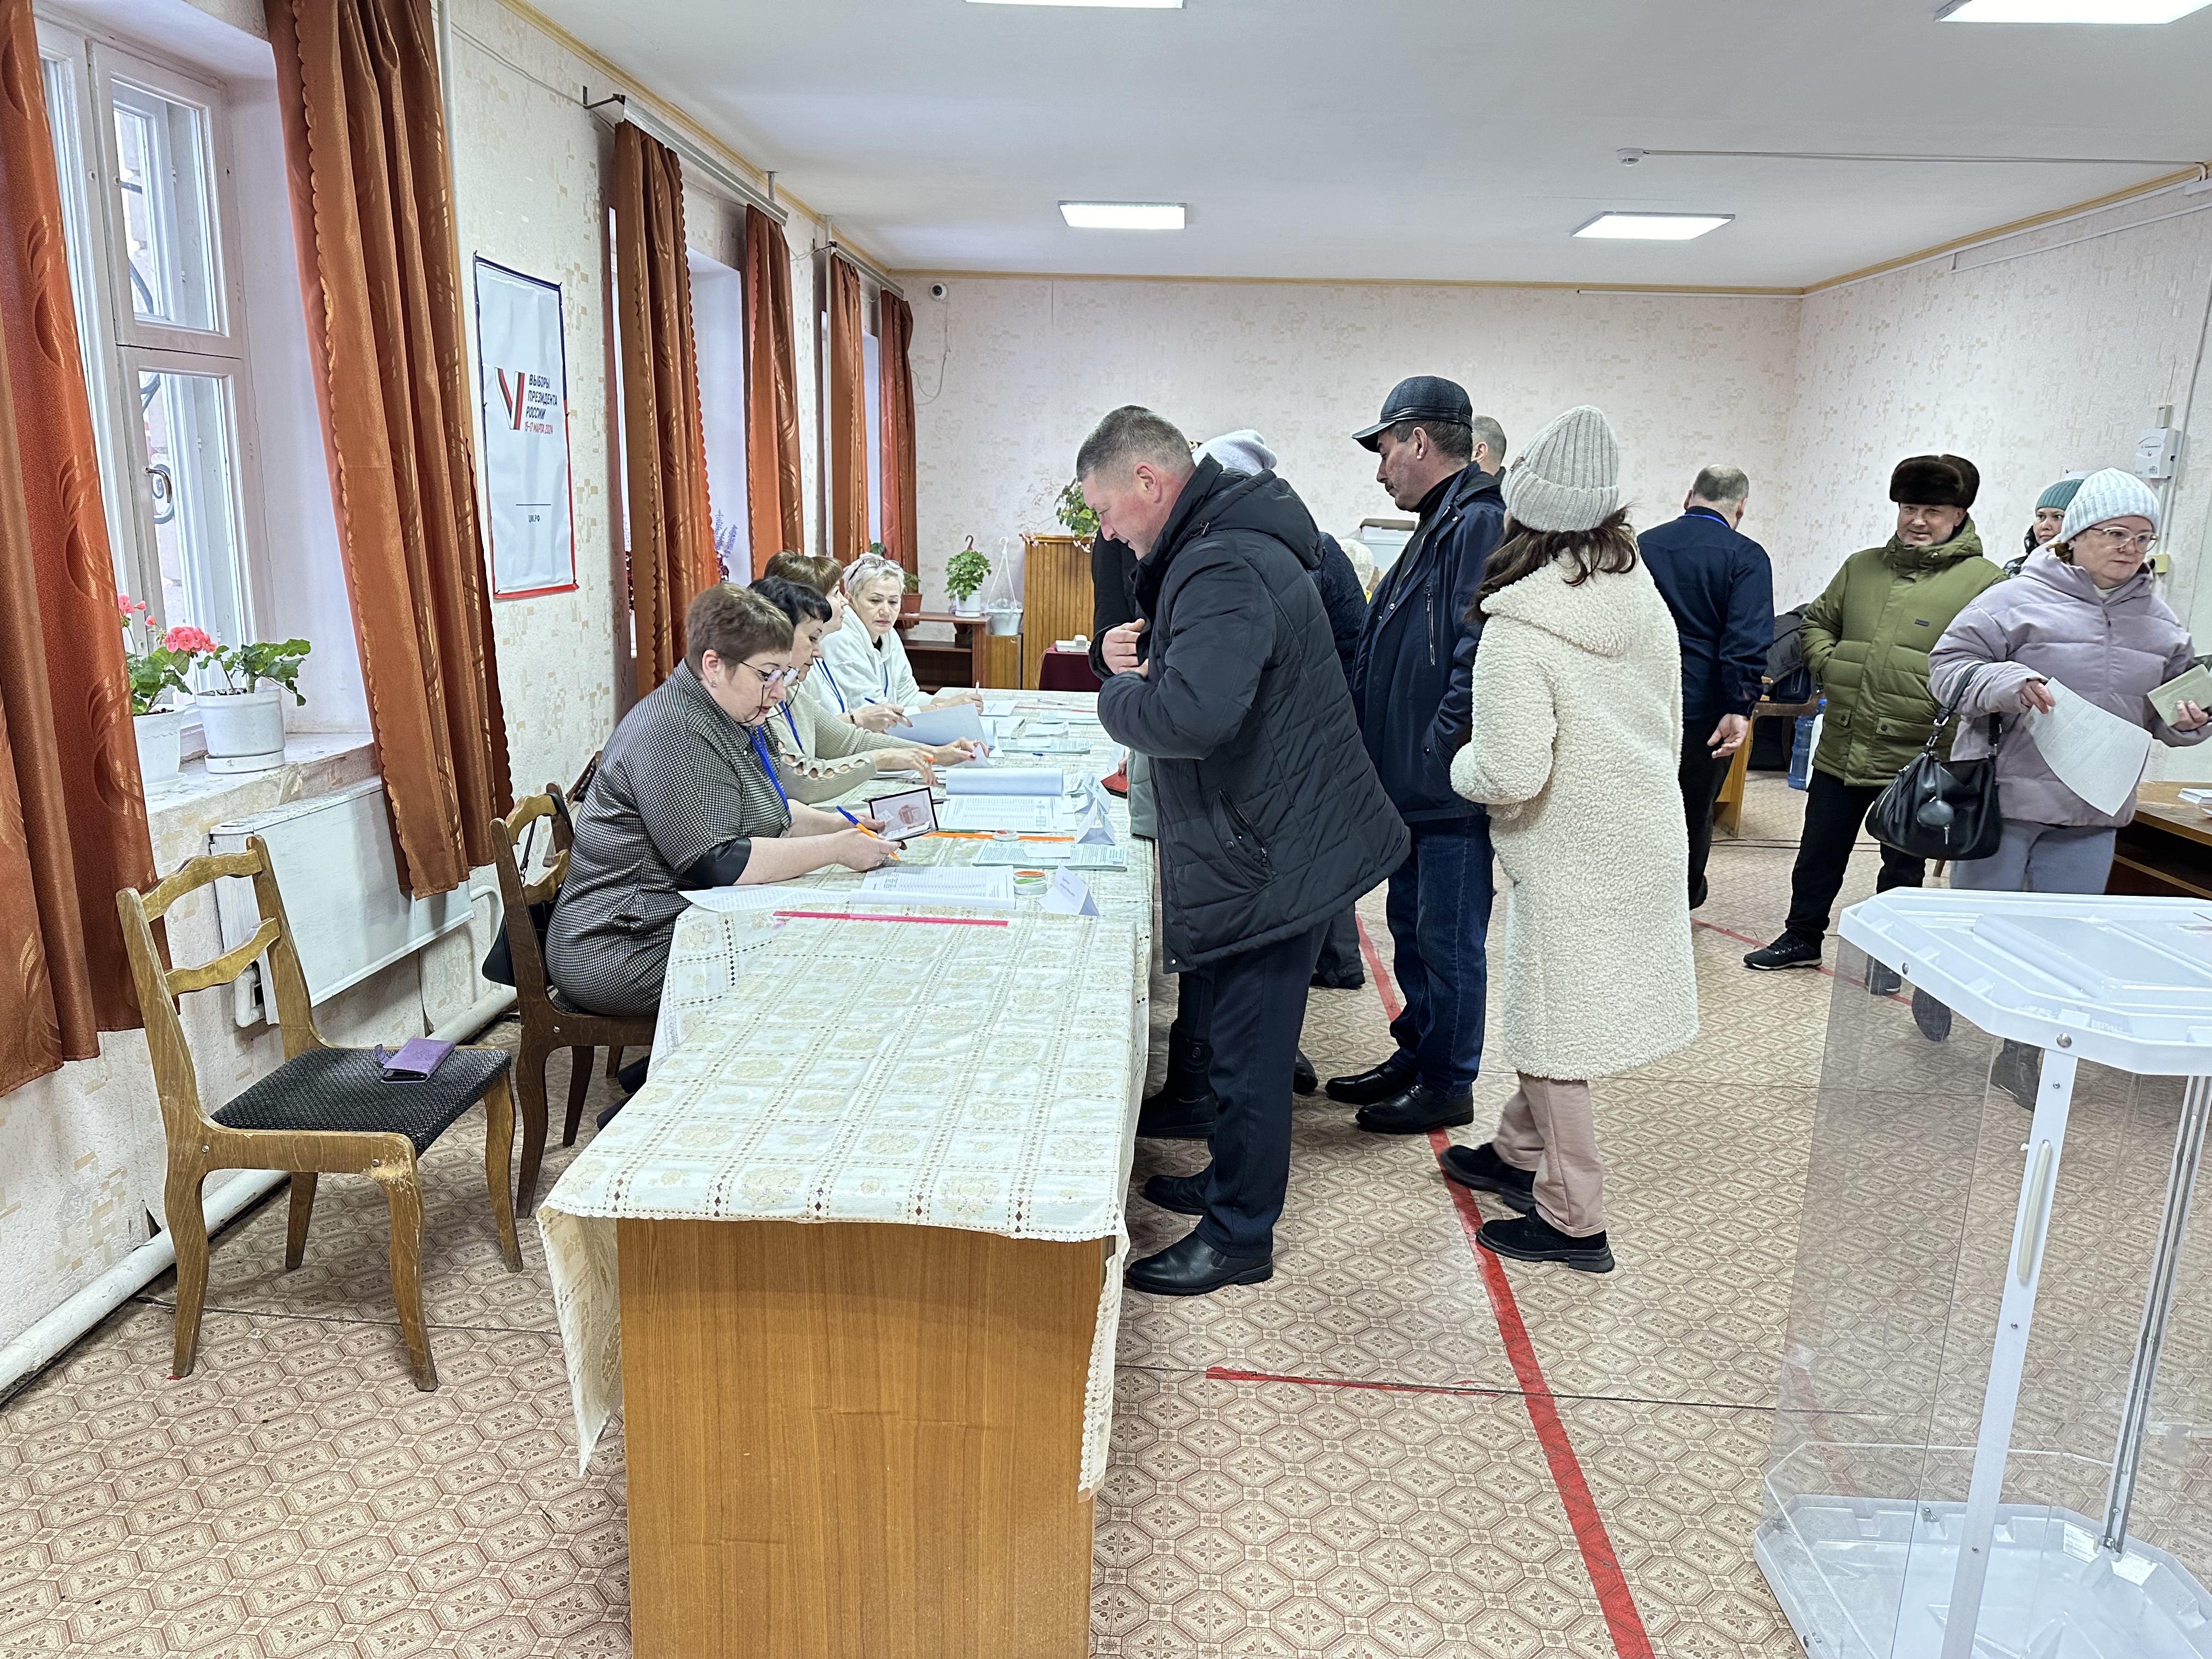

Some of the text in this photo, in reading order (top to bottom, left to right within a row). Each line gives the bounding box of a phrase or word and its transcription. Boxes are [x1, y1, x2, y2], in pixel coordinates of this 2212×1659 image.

[529, 374, 550, 389] ВЫБОРЫ
[528, 390, 557, 406] ПРЕЗИДЕНТА
[526, 406, 546, 420] РОССИИ
